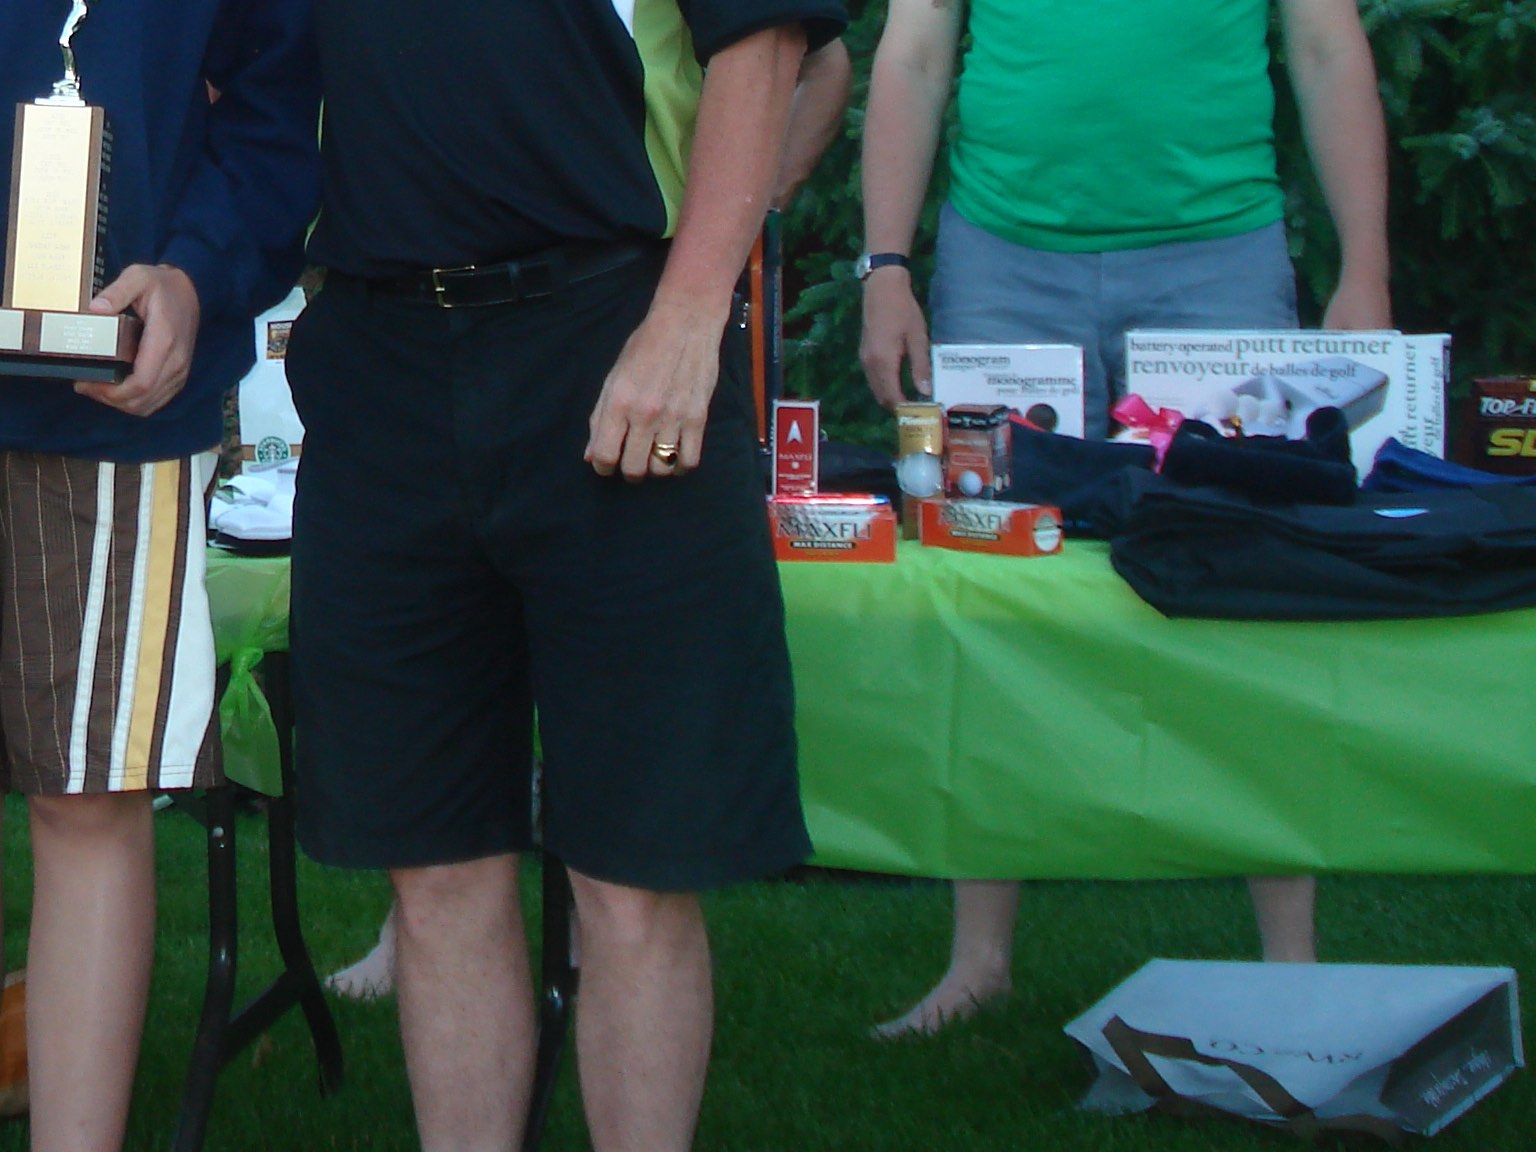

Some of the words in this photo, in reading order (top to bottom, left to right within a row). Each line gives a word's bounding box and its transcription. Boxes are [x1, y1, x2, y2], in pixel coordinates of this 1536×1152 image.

[1235, 337, 1287, 359] putt
[1292, 338, 1392, 355] returner
[941, 355, 1011, 366] monogram
[1131, 359, 1250, 381] renvoyeur
[987, 377, 1076, 387] monogramme
[1405, 343, 1417, 420] returner
[778, 522, 871, 538] MAXFLI
